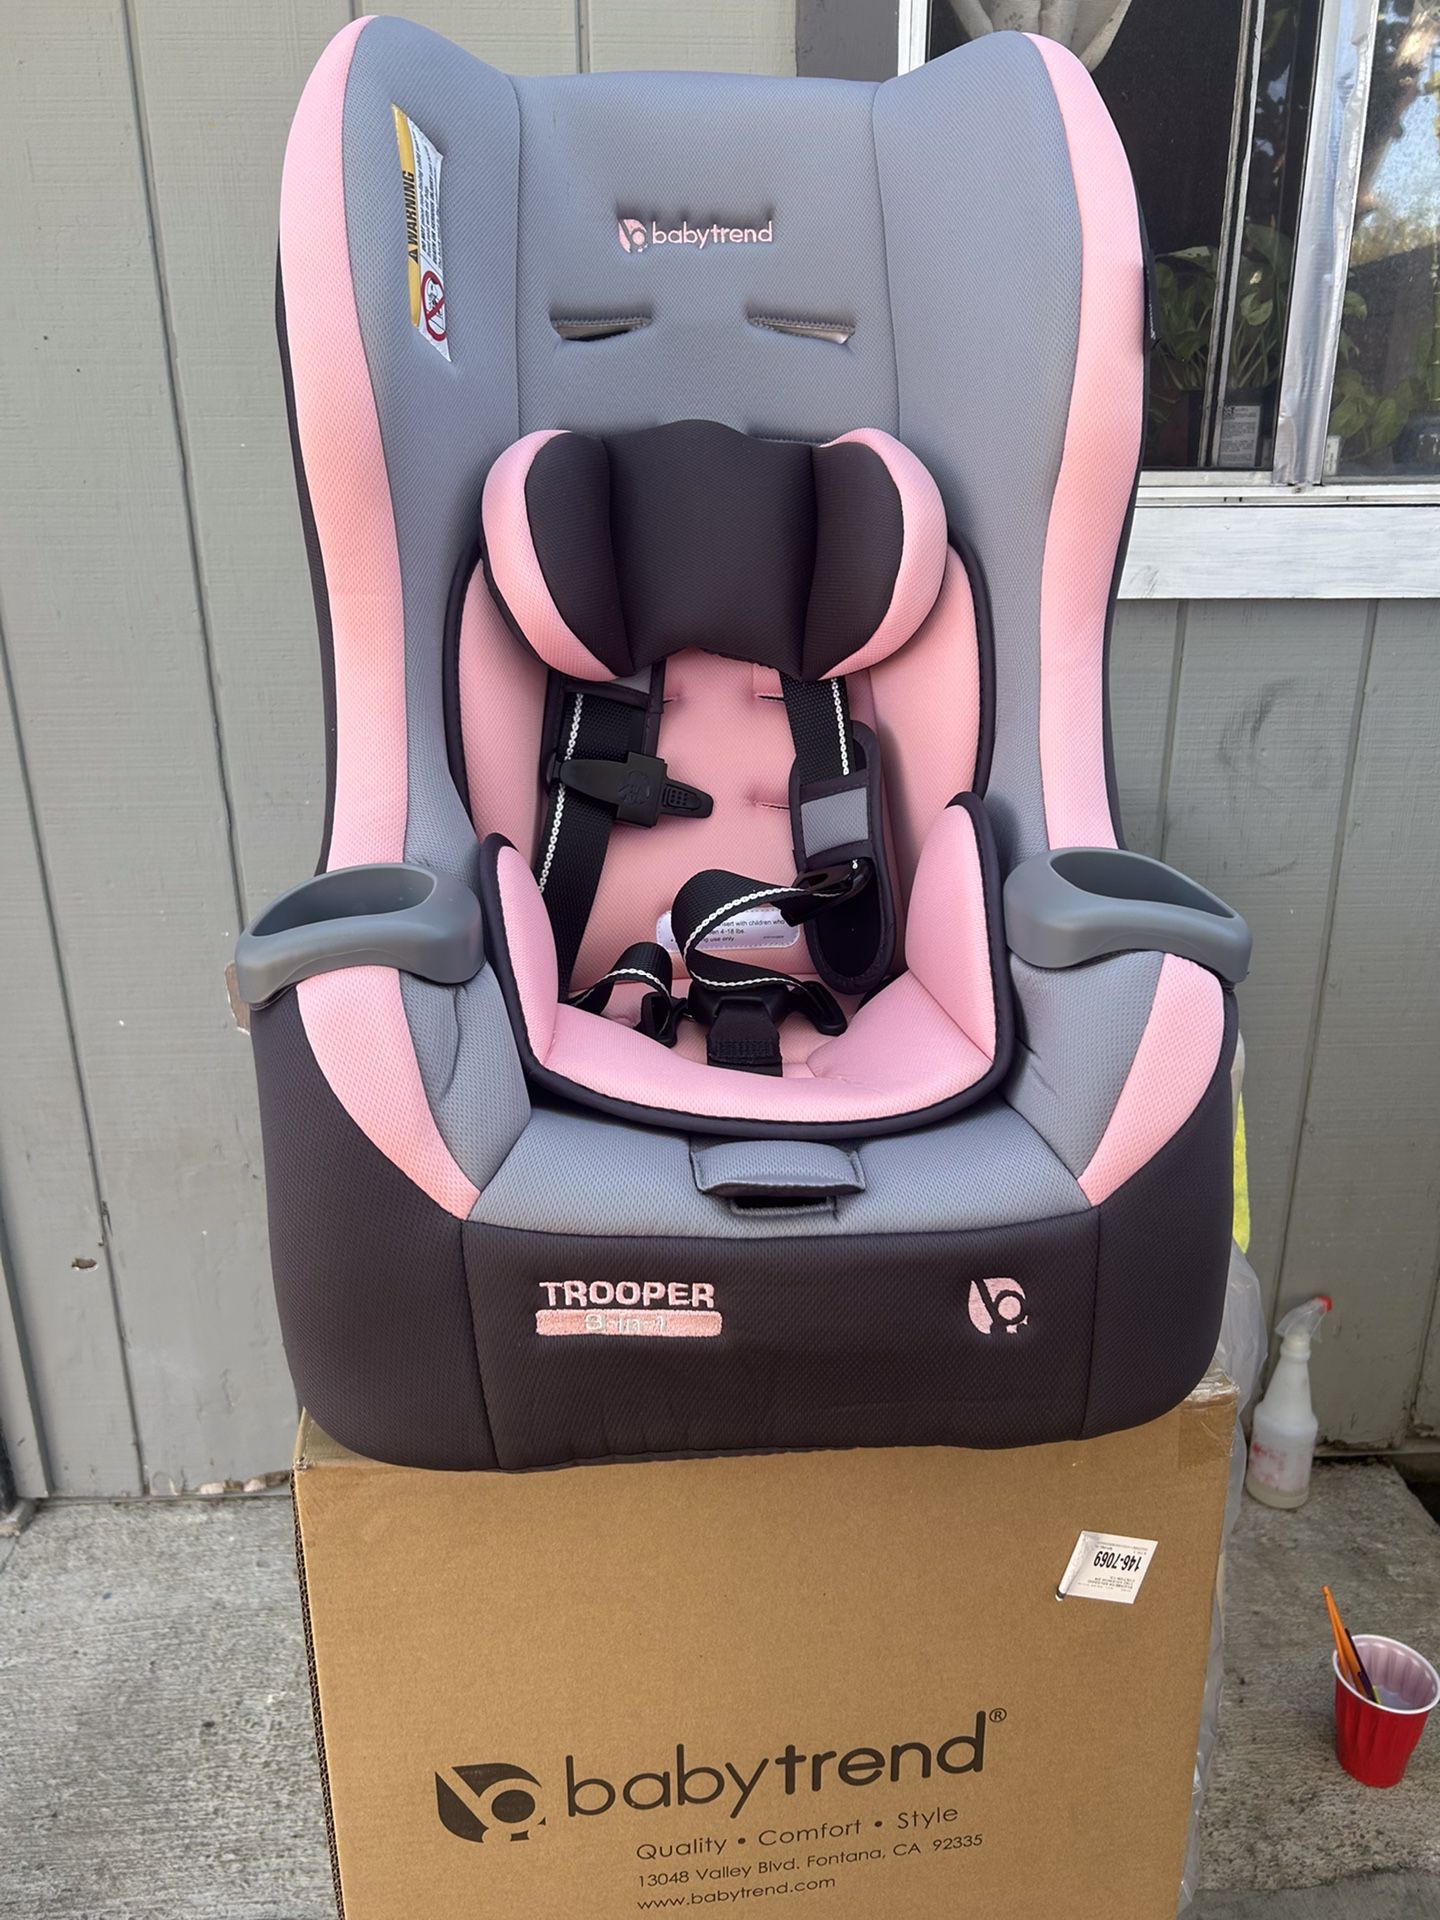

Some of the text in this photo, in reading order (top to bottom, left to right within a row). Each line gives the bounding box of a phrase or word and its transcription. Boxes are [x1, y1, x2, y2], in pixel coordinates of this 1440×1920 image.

[402, 171, 417, 245] WARNING
[652, 220, 773, 250] babytrend
[538, 1280, 715, 1309] TROOPER
[1093, 1550, 1142, 1573] 146-7069
[635, 1806, 959, 1861] Quality Comfort Style
[638, 1833, 984, 1888] 13048 Valley Blvd. Fontana, CA 92335
[636, 1877, 837, 1910] www.babytrend.com
